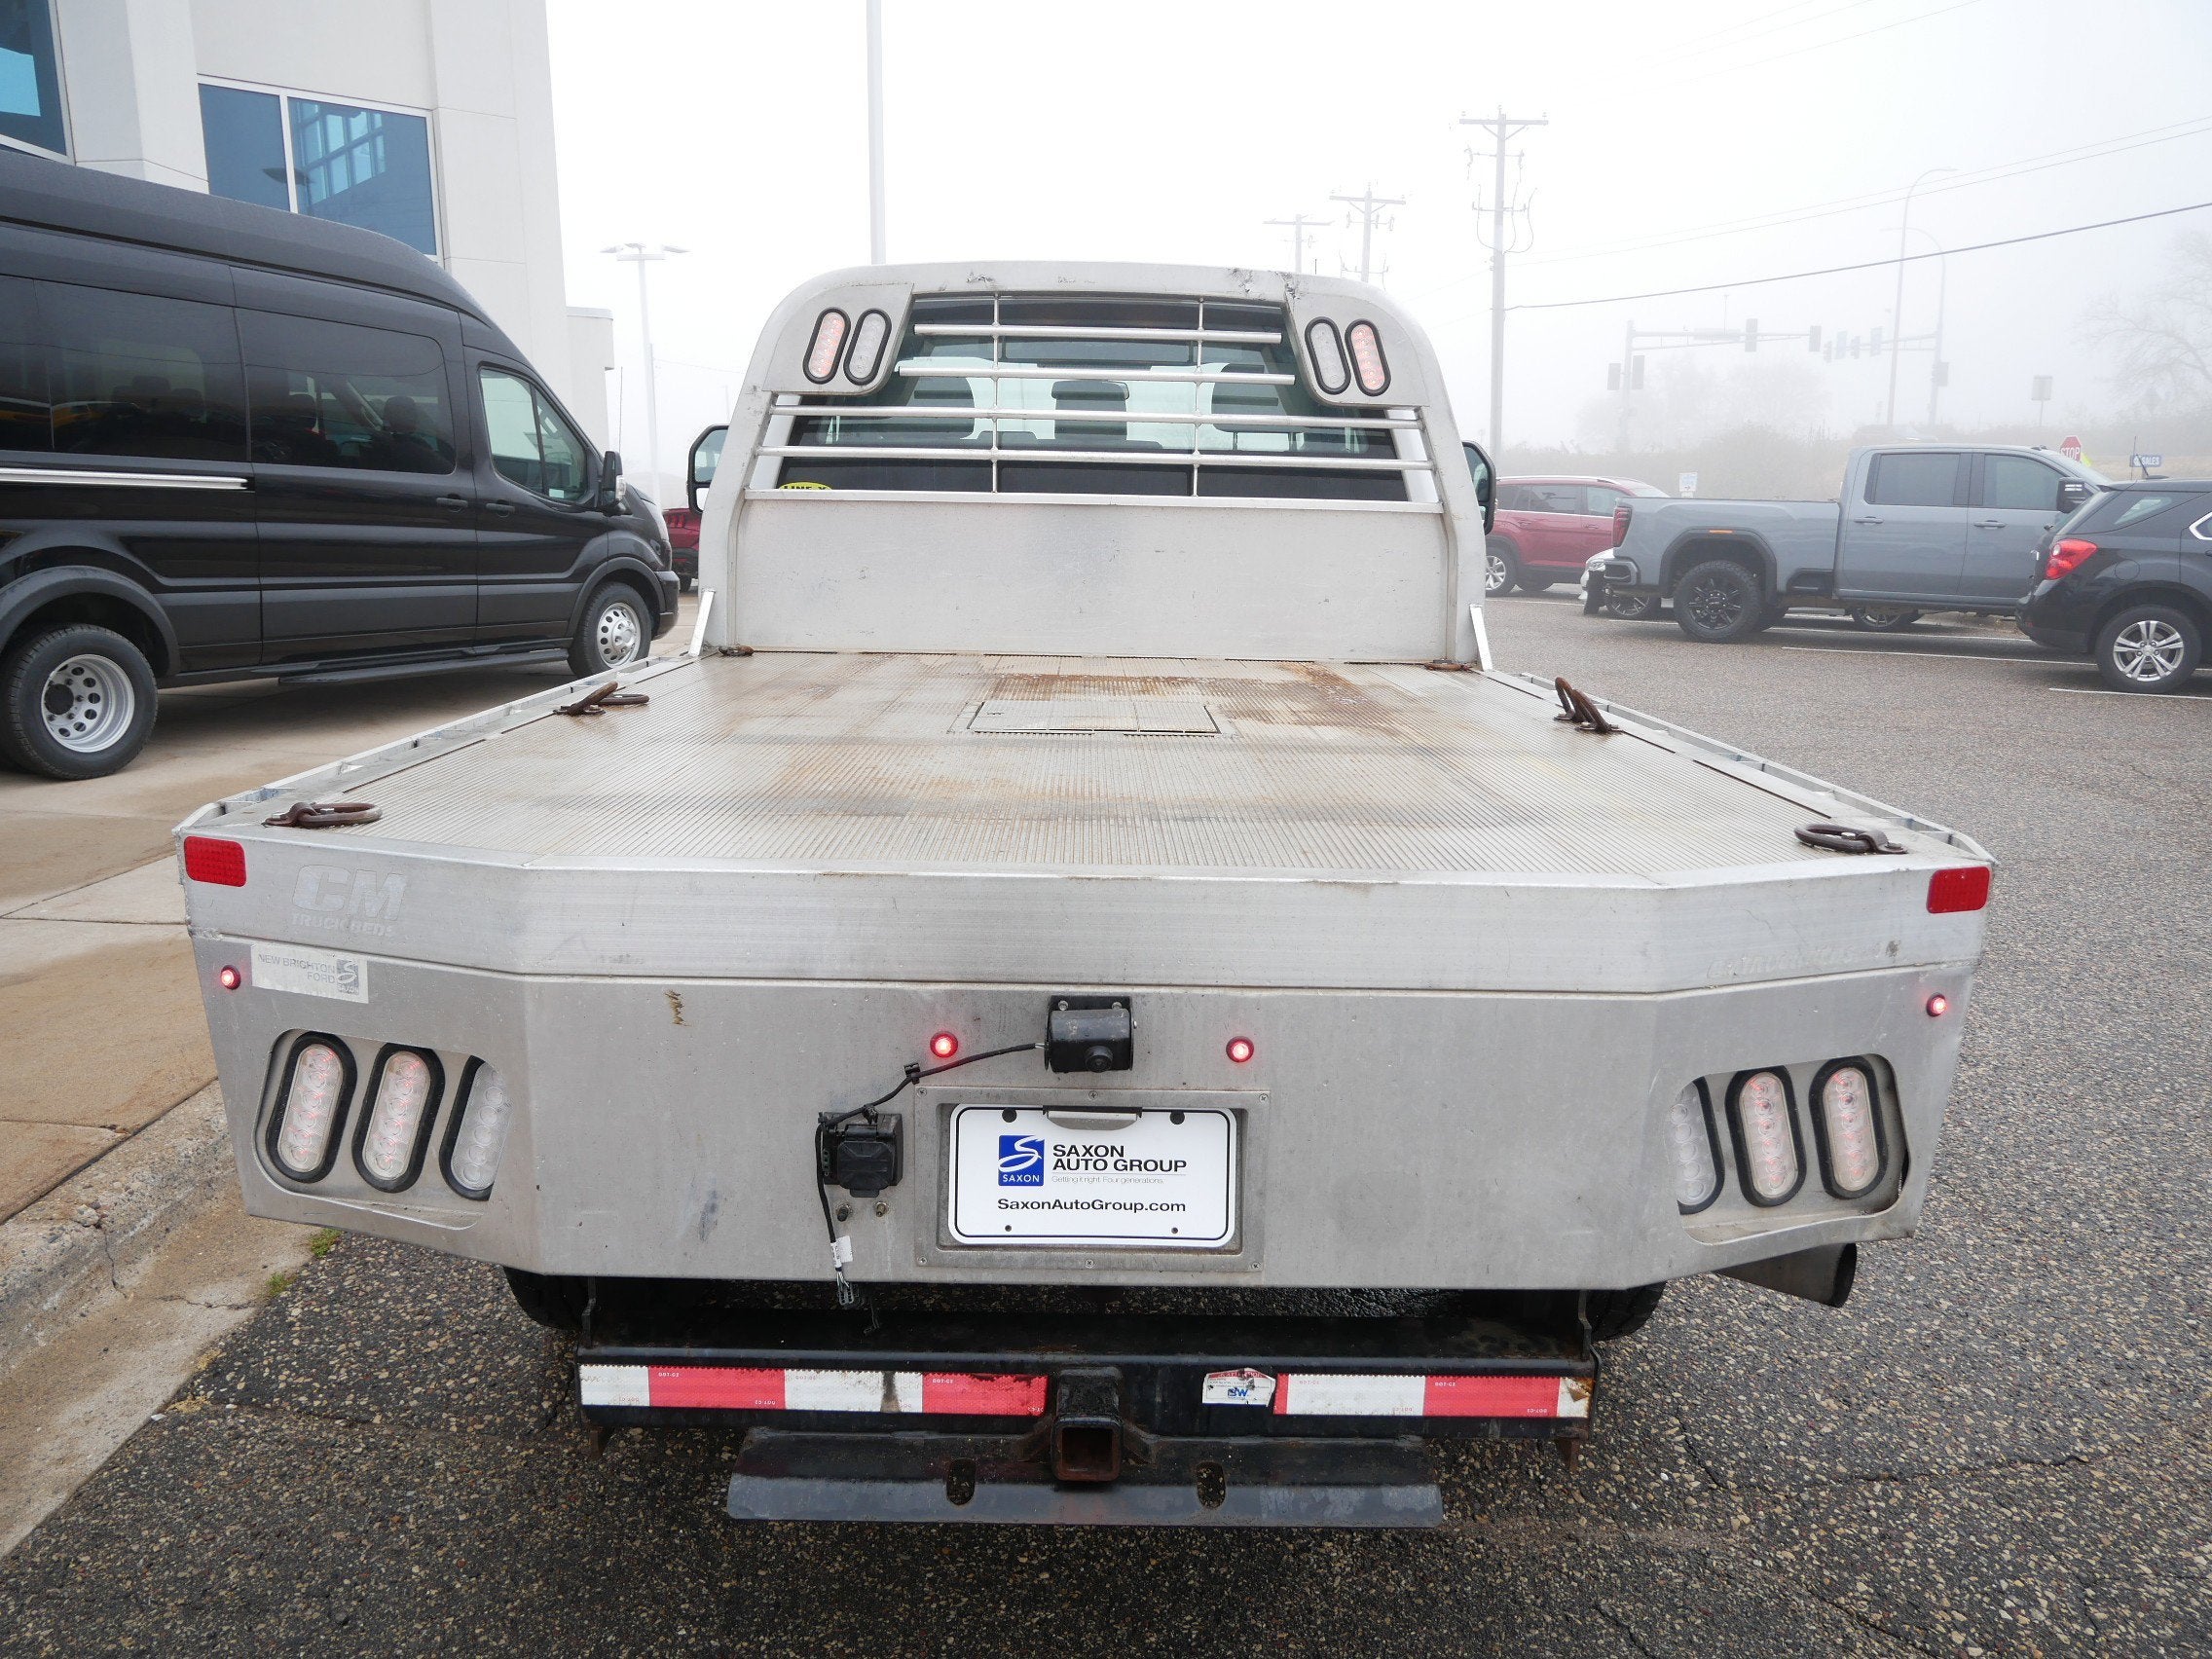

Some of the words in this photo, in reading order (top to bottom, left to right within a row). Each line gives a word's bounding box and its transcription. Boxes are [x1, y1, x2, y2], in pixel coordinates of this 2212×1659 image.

[258, 954, 280, 965] NEW
[282, 957, 335, 974] BRIGHTON
[307, 972, 335, 984] FORD
[1052, 1144, 1124, 1158] SAXON
[1052, 1159, 1109, 1171] AUTO
[1113, 1159, 1187, 1172] GROUP
[1002, 1174, 1040, 1183] SAXON
[998, 1198, 1186, 1213] SaxonAutoGroup.com
